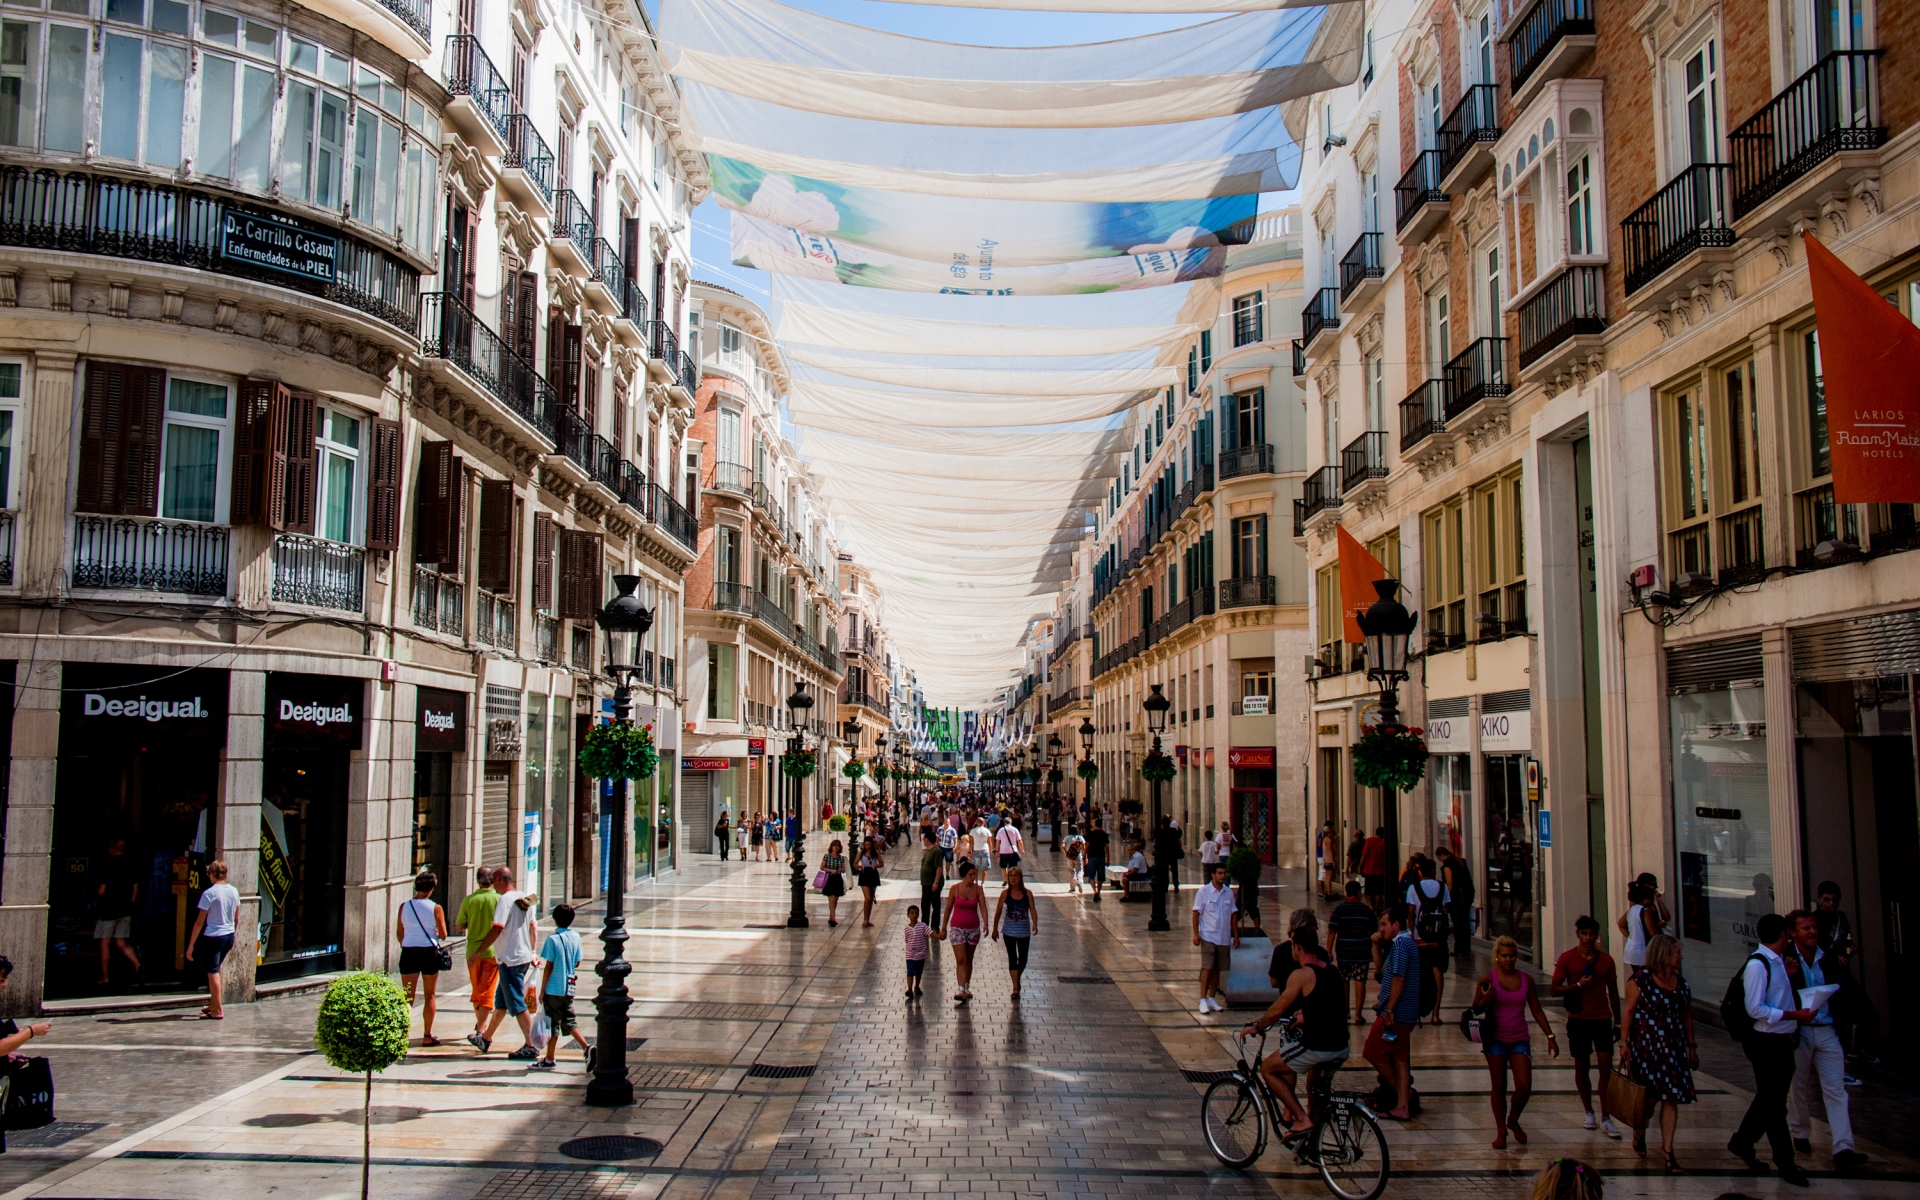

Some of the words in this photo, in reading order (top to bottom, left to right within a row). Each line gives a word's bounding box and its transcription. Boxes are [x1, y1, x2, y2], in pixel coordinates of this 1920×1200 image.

[226, 214, 243, 236] Dr.
[246, 221, 292, 248] Carrillo
[295, 234, 335, 259] Casaux
[229, 240, 291, 267] Enfermedades
[291, 259, 299, 270] de
[300, 261, 305, 271] la
[306, 260, 332, 278] PIEL
[1855, 410, 1904, 420] LARIOS
[1836, 431, 1885, 445] Room
[1863, 450, 1904, 458] HOTELS
[84, 693, 201, 722] Desigual
[280, 699, 349, 726] Desigual
[424, 709, 454, 732] Desigual
[1428, 720, 1451, 739] KIKO
[1481, 715, 1509, 737] KIKO
[1241, 753, 1270, 764] CajaSur
[70, 864, 84, 873] 50
[269, 857, 290, 892] final
[1733, 921, 1758, 938] CARA
